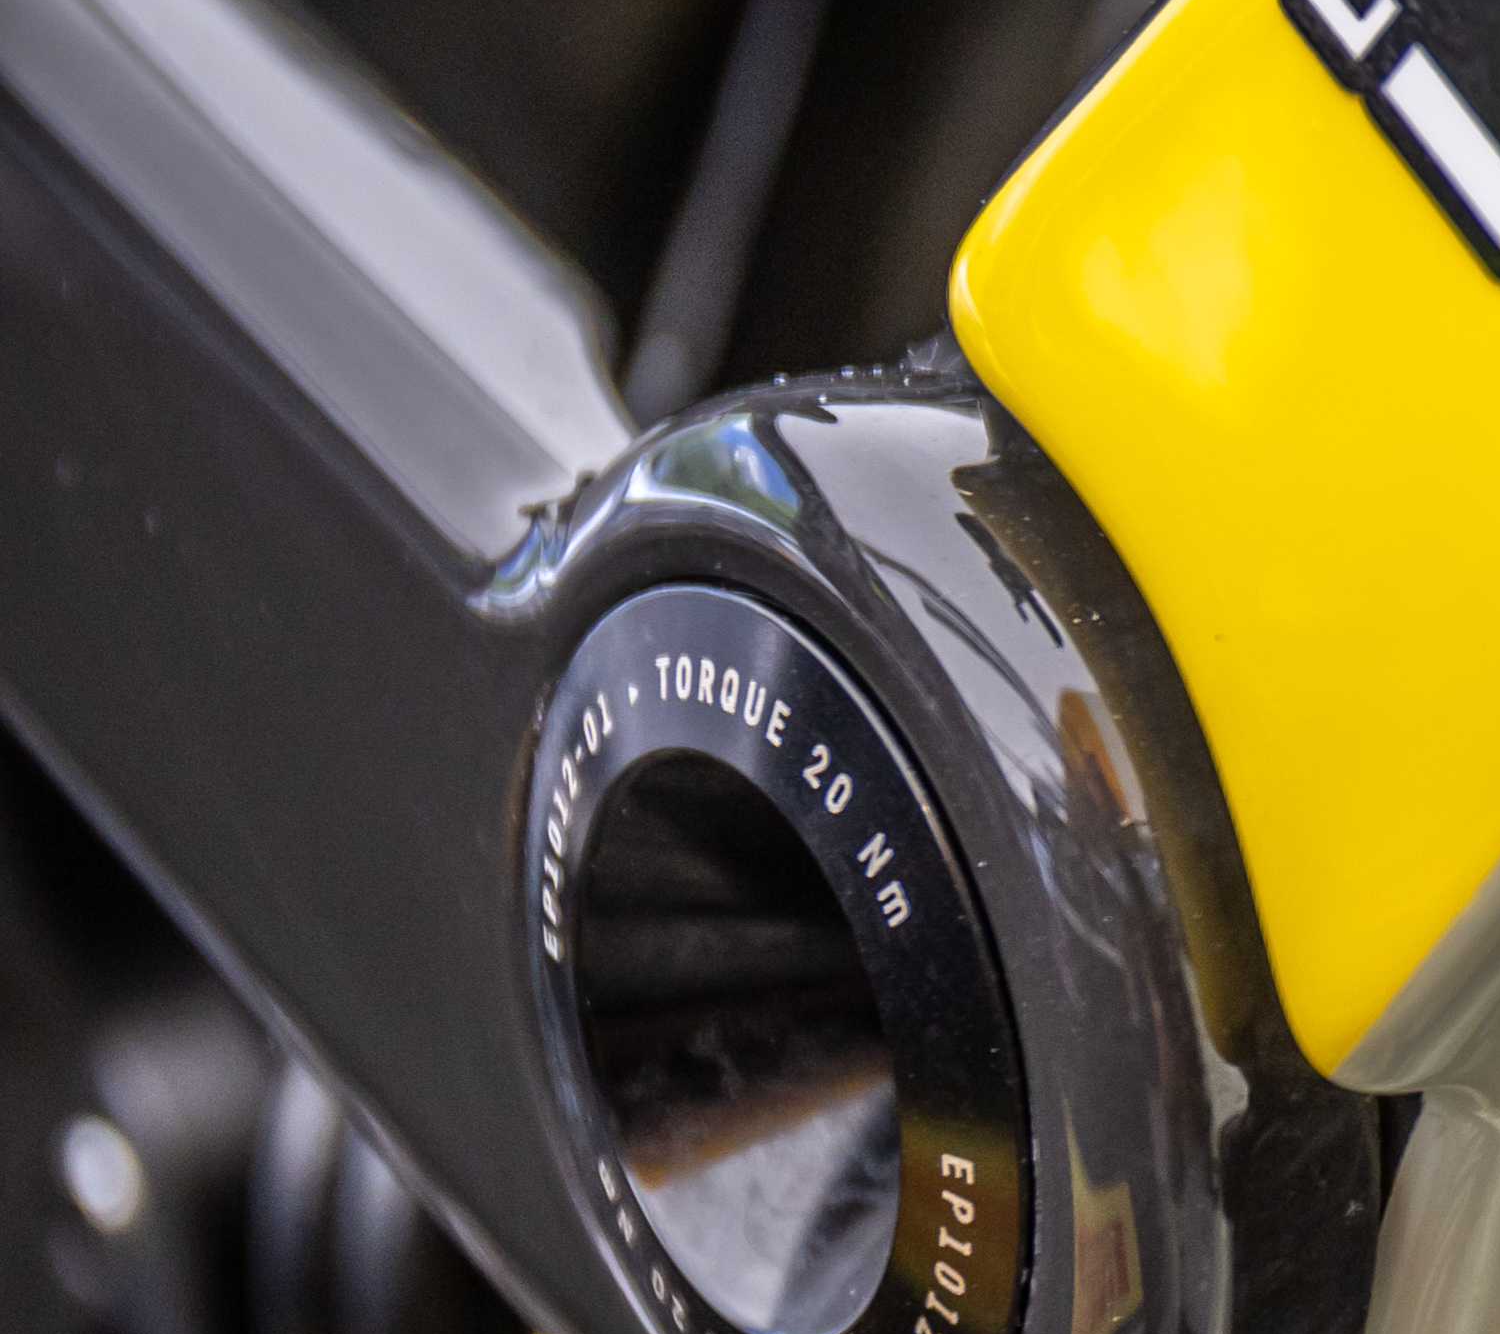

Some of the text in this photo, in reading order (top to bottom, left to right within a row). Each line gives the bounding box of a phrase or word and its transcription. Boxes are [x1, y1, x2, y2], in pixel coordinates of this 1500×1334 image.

[654, 652, 792, 748] TORQUE
[801, 742, 853, 815] 20
[856, 831, 911, 929] Nm
[652, 1266, 687, 1334] 20
